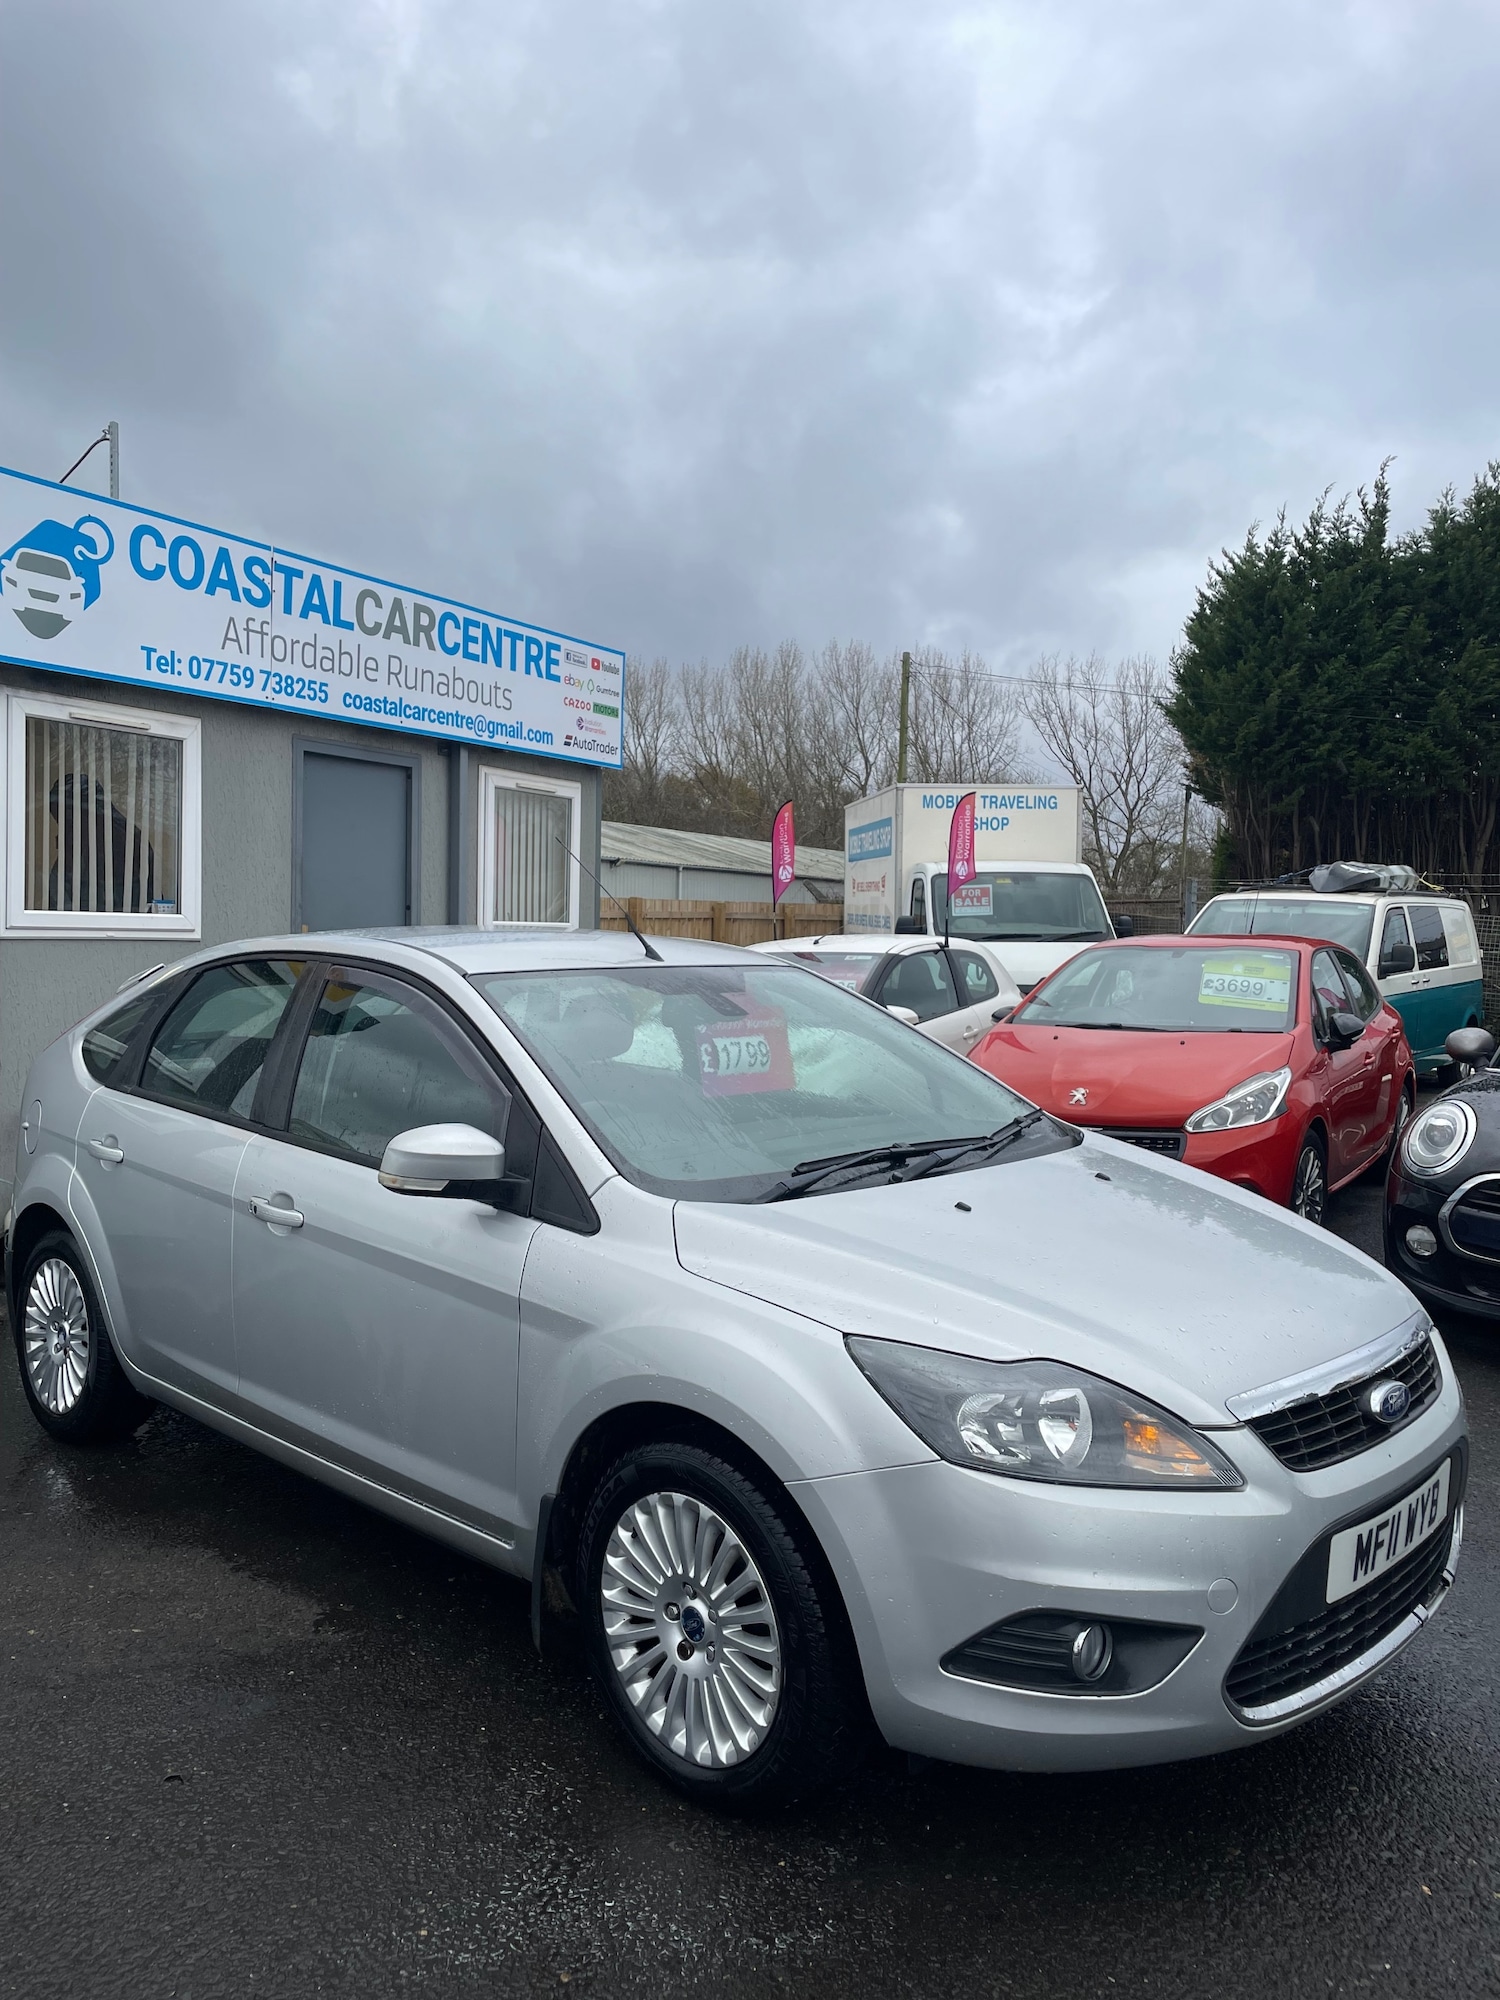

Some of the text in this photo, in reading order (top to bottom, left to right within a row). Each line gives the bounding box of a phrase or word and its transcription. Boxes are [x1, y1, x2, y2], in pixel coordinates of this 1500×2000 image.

[129, 523, 561, 683] COASTALCARCENTRE
[221, 616, 513, 711] Affordable Runabouts
[601, 661, 620, 676] YouTube
[564, 673, 584, 691] ebay
[140, 645, 554, 746] Tel: 07759 738255 coastalcarcentre@gmail.com
[596, 685, 620, 698] Gumtree
[563, 696, 591, 711] CAZOO
[572, 736, 618, 756] AutoTrader
[981, 795, 1058, 810] TRAVELING
[955, 815, 963, 859] Evolution
[963, 804, 971, 859] Warranties
[955, 897, 989, 906] SALE
[962, 889, 981, 897] FOR
[1203, 978, 1264, 996] £3699
[1352, 1479, 1440, 1582] MF11 WYB
